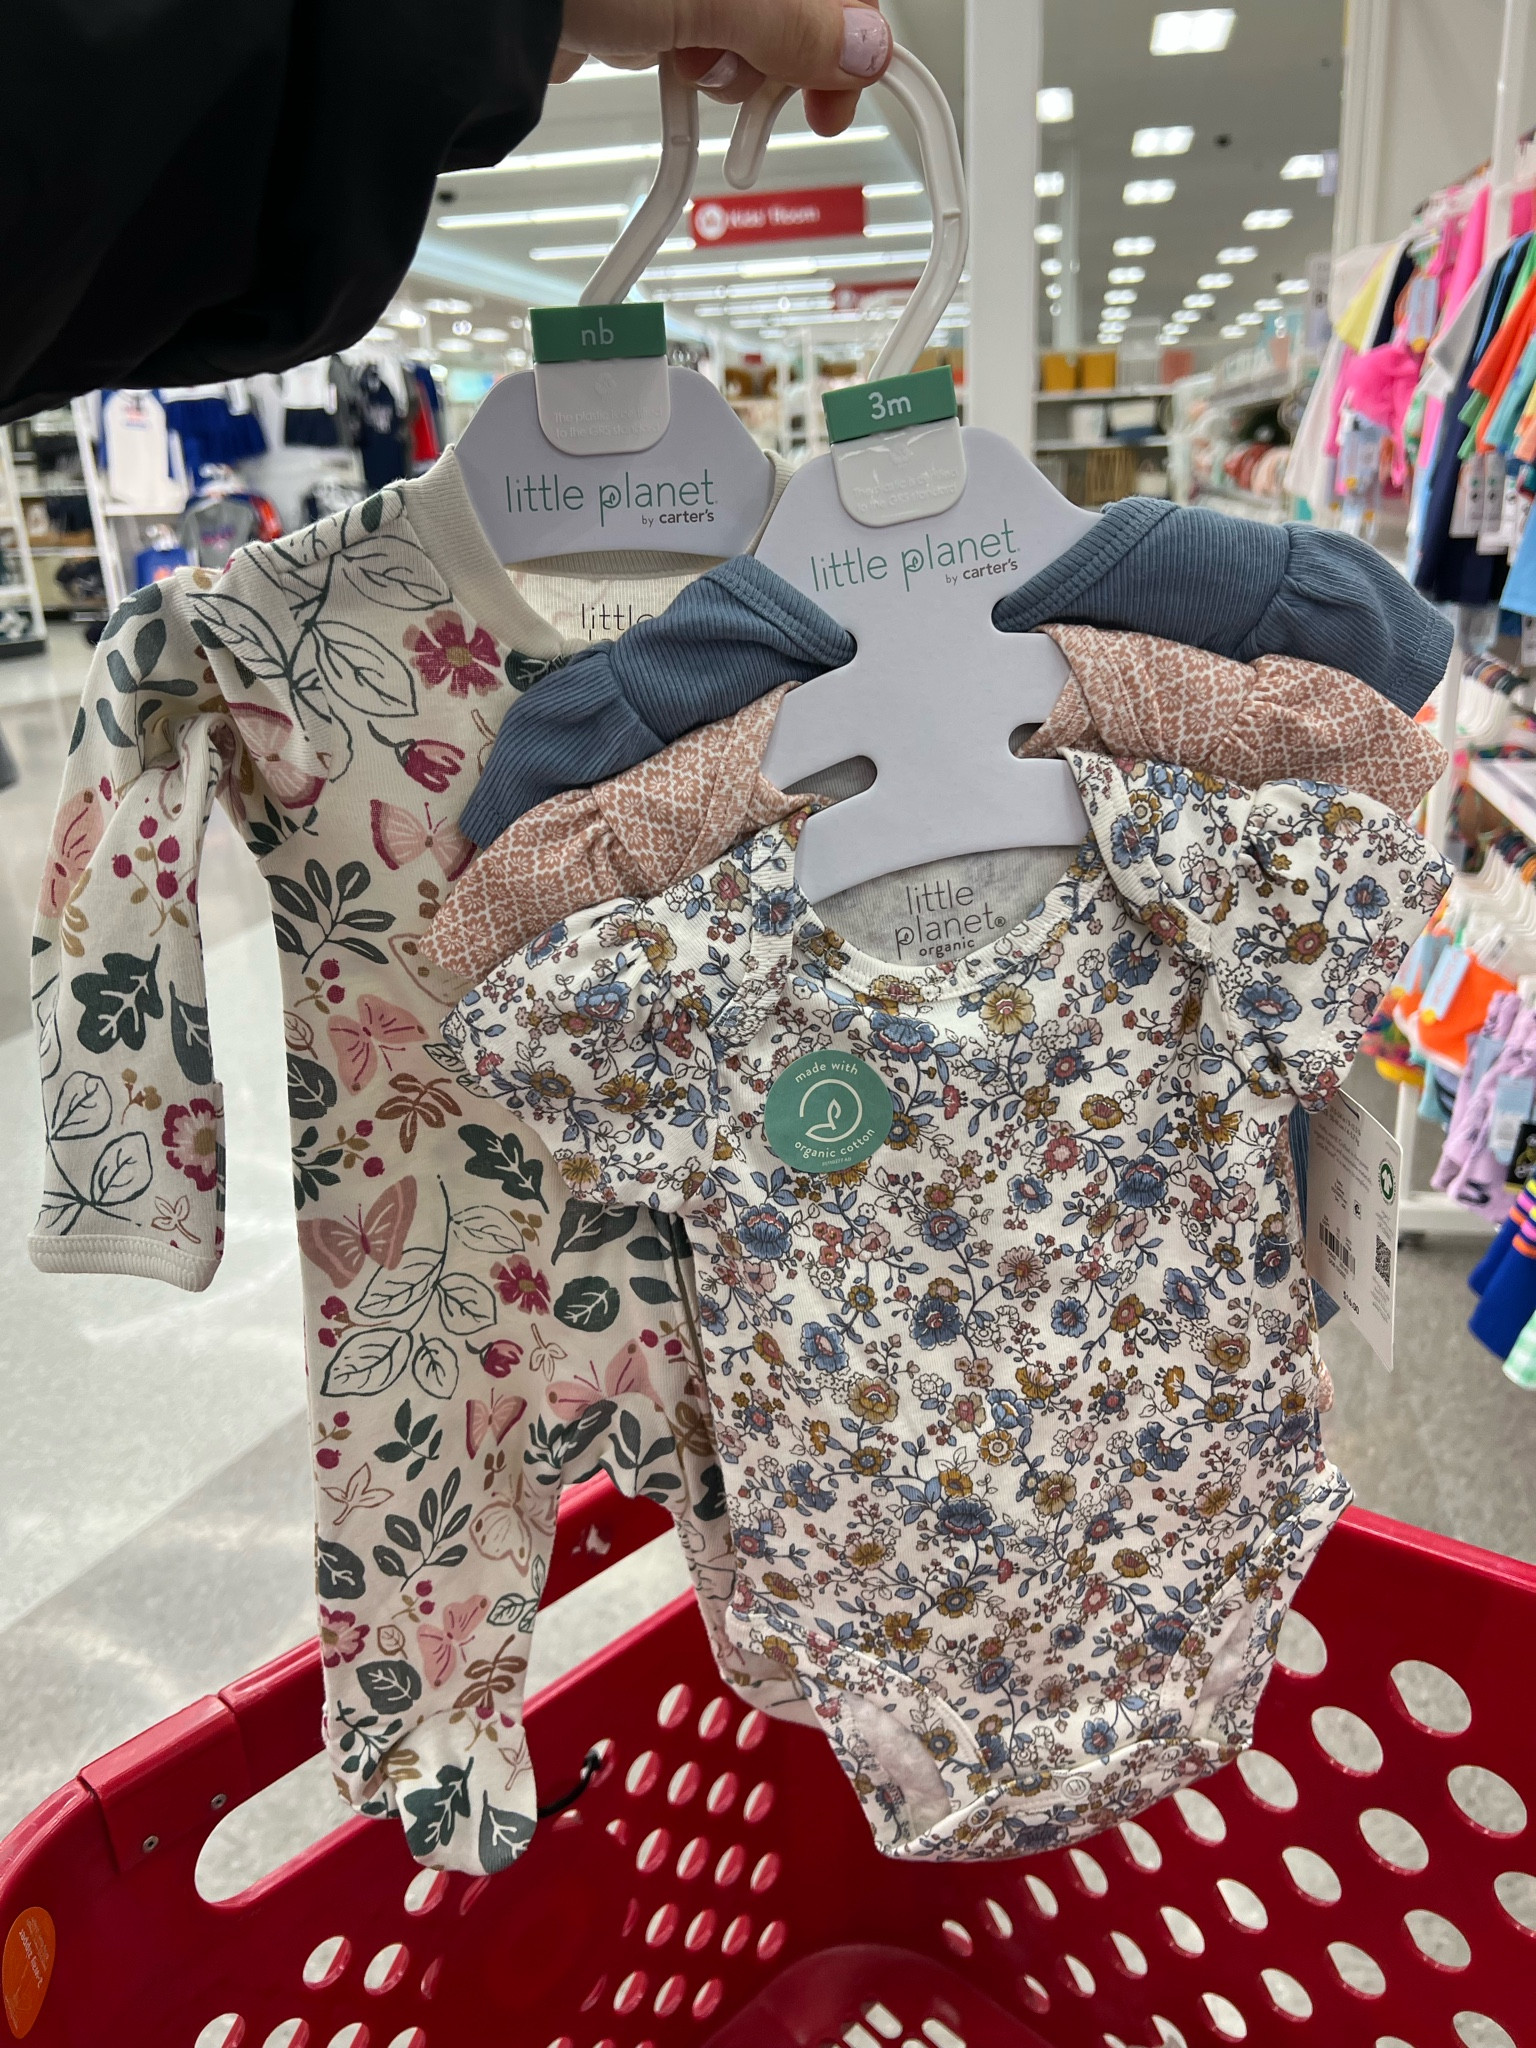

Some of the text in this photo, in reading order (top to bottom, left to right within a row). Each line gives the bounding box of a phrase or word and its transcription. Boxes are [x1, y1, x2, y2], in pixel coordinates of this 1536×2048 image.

[581, 317, 614, 346] nb
[868, 391, 912, 420] 3m
[506, 469, 714, 527] little planet
[642, 509, 715, 528] by carter's
[811, 518, 1017, 592] little planet
[945, 558, 1019, 586] by carter's
[906, 879, 974, 915] little
[919, 936, 975, 958] organic
[795, 1060, 858, 1083] made with
[794, 1129, 876, 1159] organic cotton
